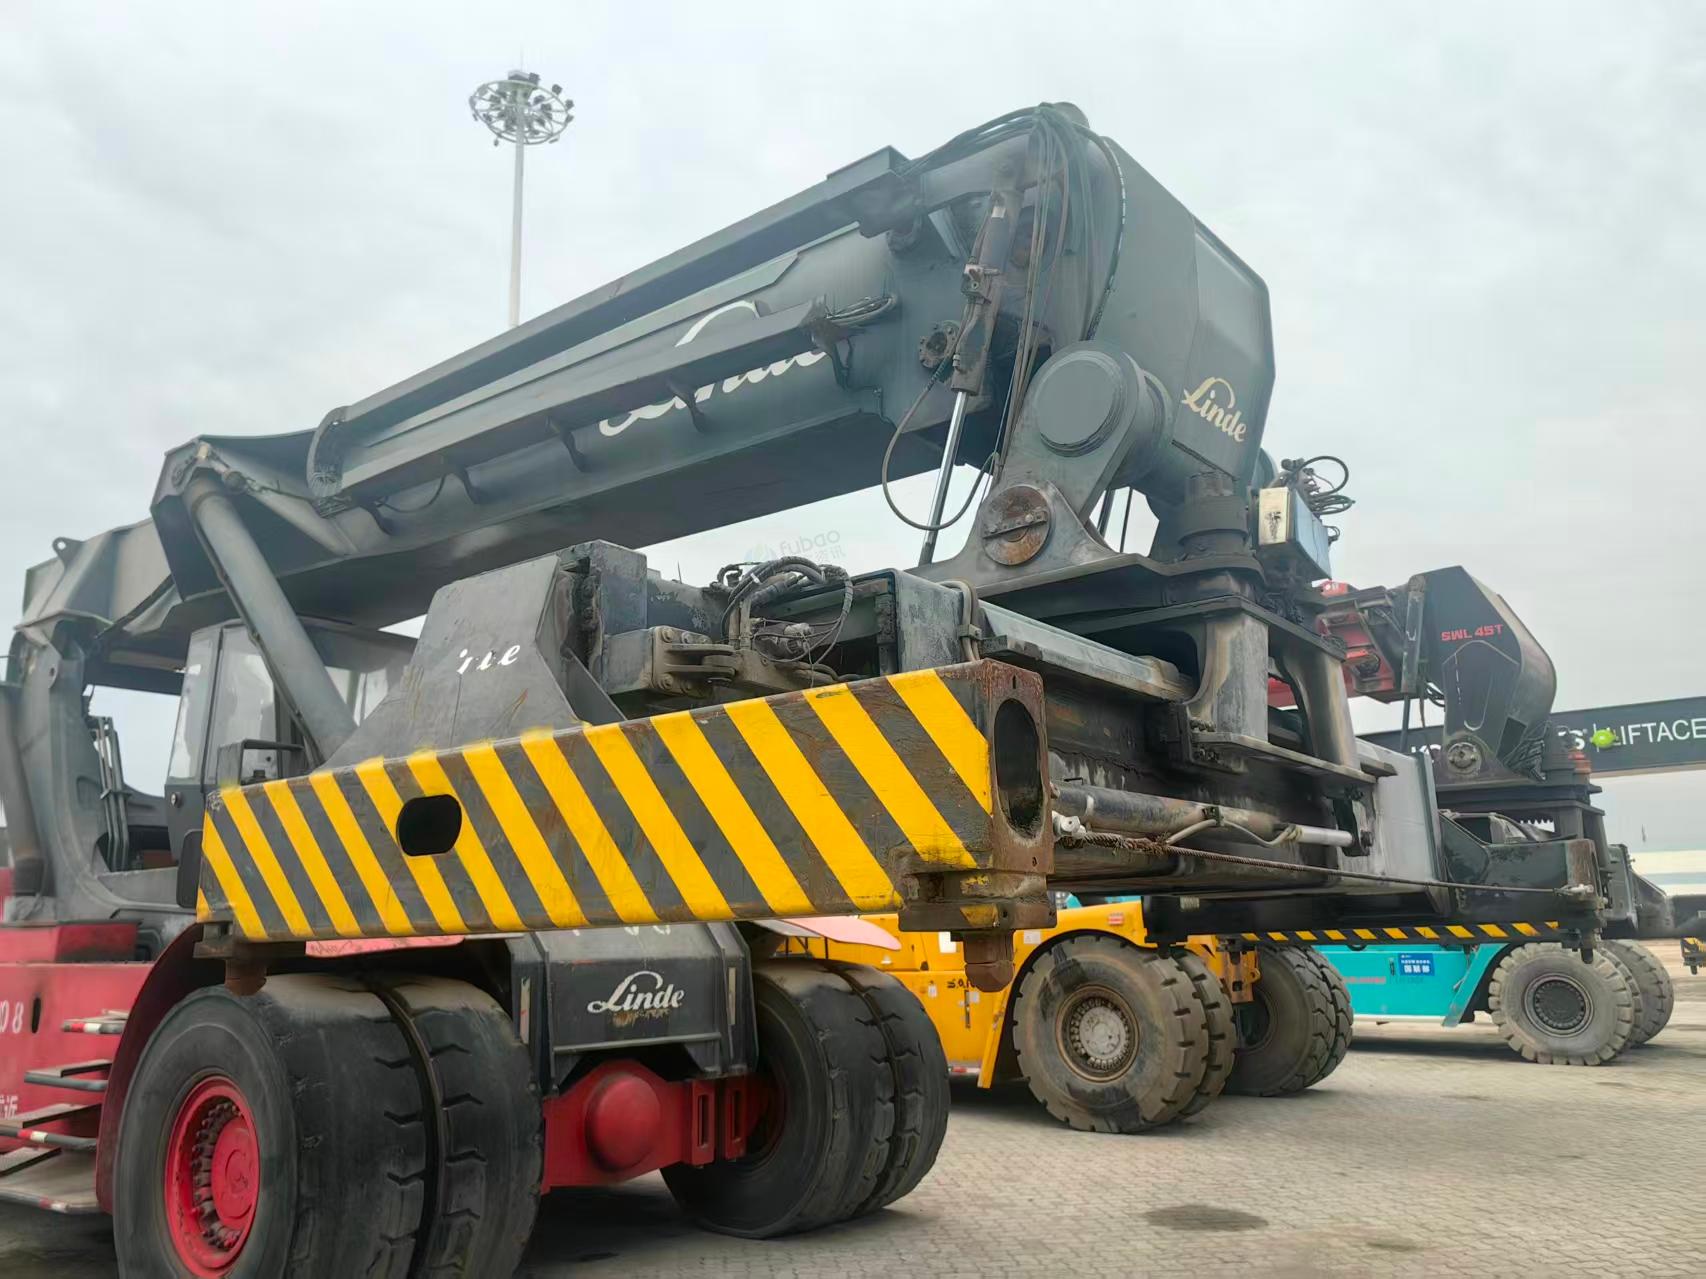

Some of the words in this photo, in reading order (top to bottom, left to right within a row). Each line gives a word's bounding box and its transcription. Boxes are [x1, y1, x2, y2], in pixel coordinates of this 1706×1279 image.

[1182, 377, 1246, 442] Linde
[1441, 628, 1473, 641] SWL
[586, 970, 685, 1013] Linde
